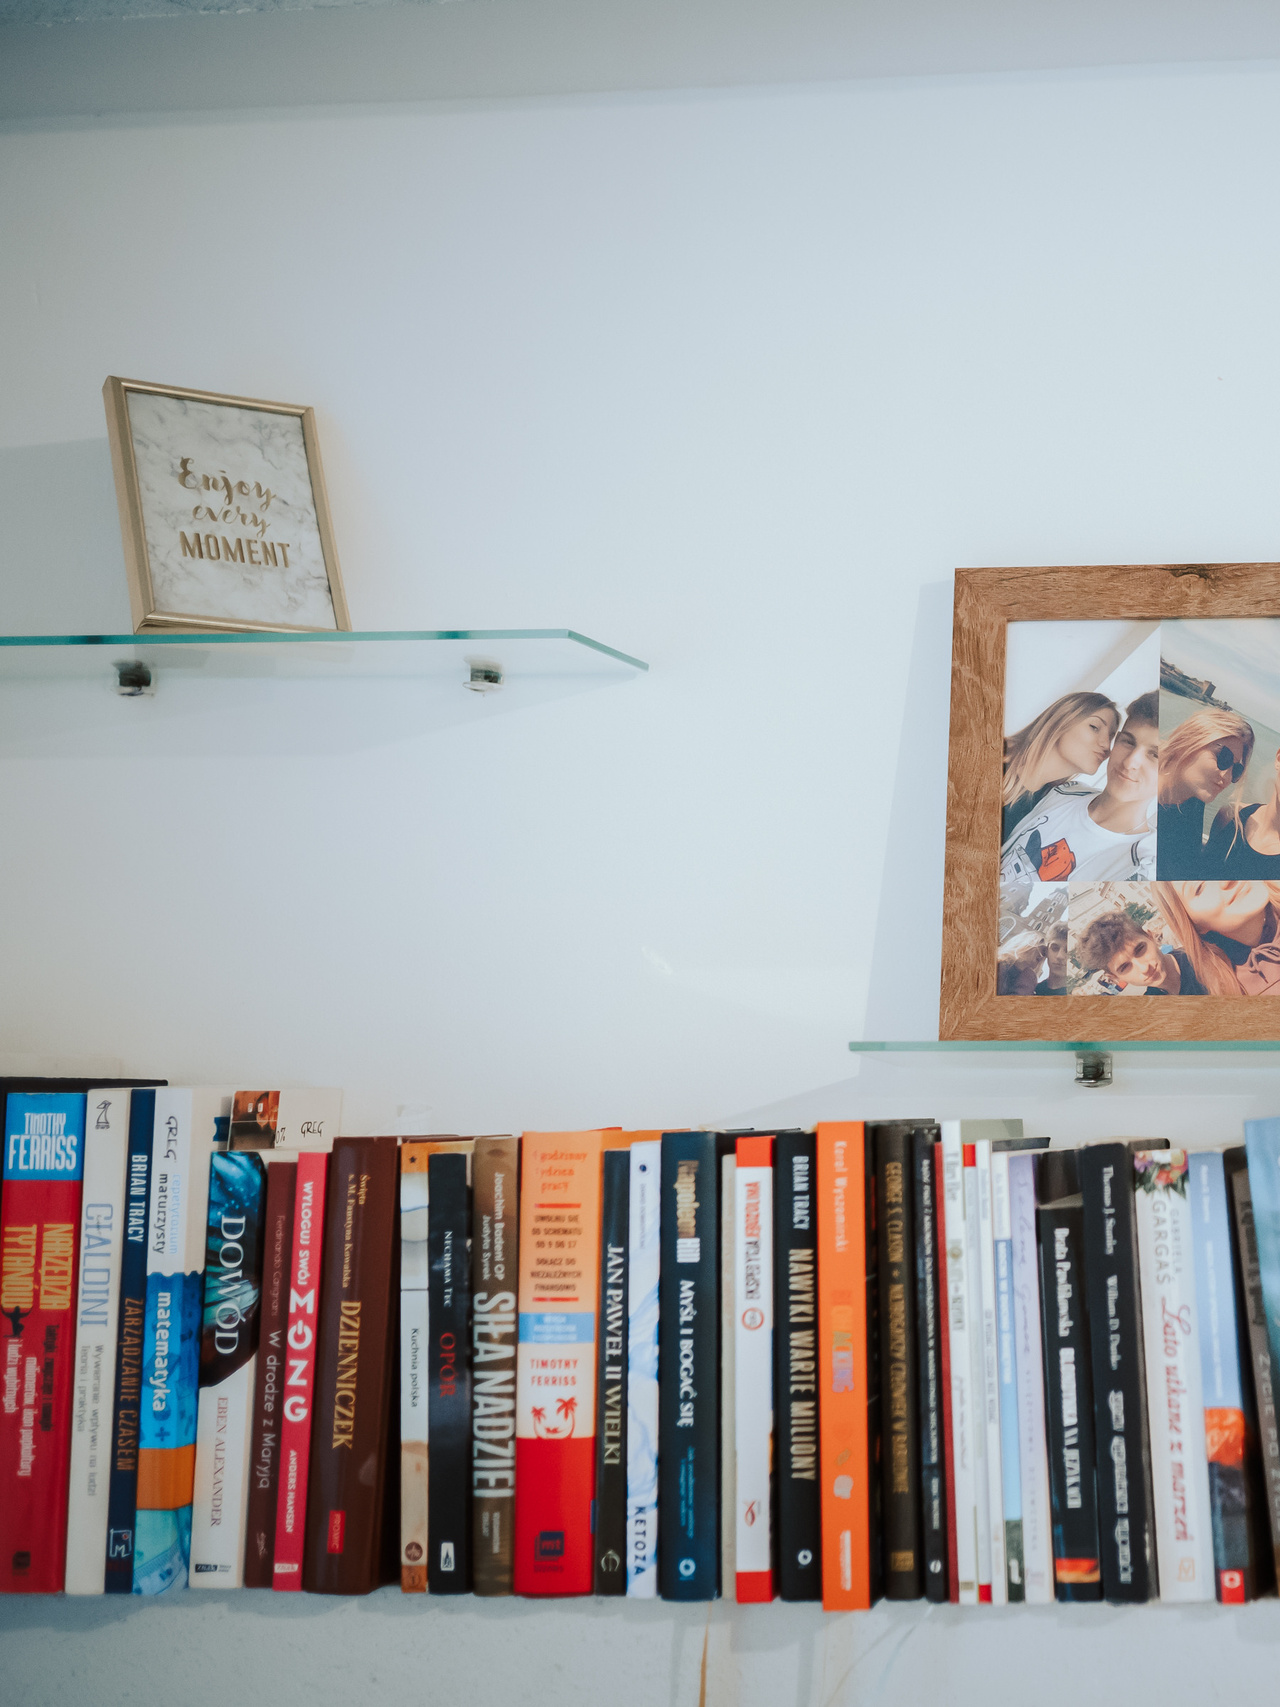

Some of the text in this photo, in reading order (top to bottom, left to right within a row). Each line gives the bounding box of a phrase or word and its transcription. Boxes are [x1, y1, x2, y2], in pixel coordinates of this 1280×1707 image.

[178, 456, 276, 511] Enjoy
[179, 531, 290, 569] MOMENT
[192, 505, 270, 538] every
[8, 1134, 77, 1171] FERRISS
[23, 1112, 67, 1135] TIMOTHY
[163, 1115, 179, 1161] GREG
[300, 1121, 325, 1138] GREG
[834, 1141, 848, 1172] Karol
[1102, 1166, 1115, 1207] Thomas
[127, 1154, 148, 1242] BRIAN TRACY
[153, 1173, 168, 1254] maturzysty
[167, 1173, 181, 1254] repetytorium
[343, 1198, 355, 1241] Faustyna
[347, 1184, 356, 1197] M.
[357, 1174, 371, 1205] Święta
[673, 1160, 701, 1263] Napoleon Hill
[792, 1156, 810, 1230] BRIAN TRACY
[272, 1215, 285, 1269] Ferdinando
[296, 1181, 314, 1286] WYLOGUJ SWÓJ
[480, 1215, 492, 1280] Judyta Syrek
[492, 1171, 506, 1280] Joachim Badeni OP
[1104, 1218, 1116, 1255] Stanley
[1152, 1200, 1175, 1285] GARGAŚ
[1172, 1209, 1181, 1274] GABRIELA
[1, 1223, 39, 1310] TYTANÓW
[38, 1223, 75, 1310] NARZĘDZIA
[80, 1203, 114, 1327] CIALDINI
[214, 1215, 247, 1354] DOWÓD
[341, 1242, 354, 1288] Kowalska
[442, 1230, 454, 1307] NECHAMA TEC
[1106, 1275, 1118, 1317] William
[680, 1279, 698, 1325] MYŚL
[1108, 1318, 1120, 1330] D.
[80, 1344, 91, 1375] Teoria
[116, 1297, 144, 1471] ZARZĄDZANIE CZASEM
[149, 1292, 173, 1412] matematyka
[332, 1301, 361, 1450] DZIENNICZEK
[408, 1328, 420, 1407] Kuchnia polska
[439, 1332, 459, 1398] OPÓR
[530, 1359, 579, 1370] TIMOTHY
[530, 1376, 577, 1386] FERRISS
[603, 1243, 624, 1465] JAN PAWEŁ II WIELKI
[679, 1338, 698, 1399] BOGAĆ
[788, 1249, 816, 1480] NAWYKI WARTE MILIONY
[77, 1385, 89, 1432] praktyka
[87, 1344, 105, 1497] Wywieranie wpływu na ludzi
[256, 1330, 282, 1489] W drodze z Maryją
[473, 1290, 516, 1499] SIŁA NADZIEI
[676, 1402, 695, 1428] SIĘ
[1161, 1296, 1194, 1542] Lato utkane z marzeń
[210, 1397, 229, 1527] EBEN ALEXANDER
[1267, 1428, 1280, 1458] PO
[284, 1450, 298, 1533] ANDERS HANSEN
[634, 1506, 647, 1577] KETOZA
